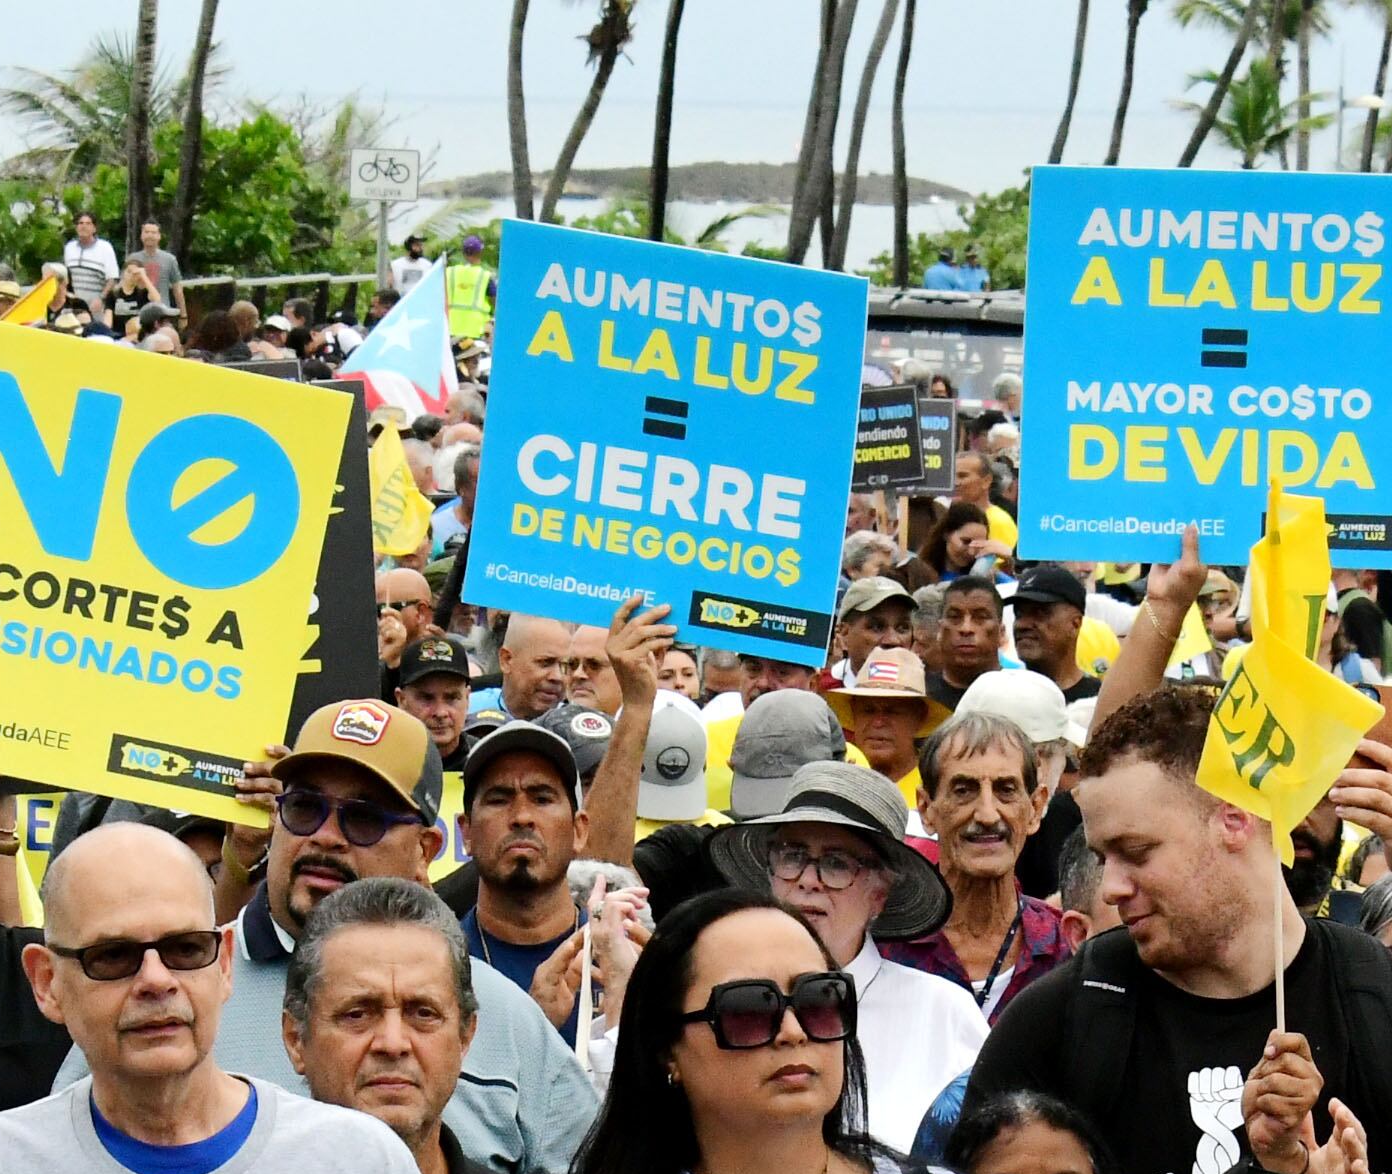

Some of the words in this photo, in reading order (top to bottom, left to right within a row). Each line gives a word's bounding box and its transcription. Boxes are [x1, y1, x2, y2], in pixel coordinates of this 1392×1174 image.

[1077, 208, 1385, 258] AUMENTO$
[536, 263, 823, 347] AUMENTO$
[1071, 256, 1122, 306] A
[1148, 257, 1236, 309] LA
[1251, 260, 1382, 315] LUZ
[527, 310, 574, 362] A
[598, 320, 680, 381] LA
[693, 341, 819, 405] LUZ
[1067, 381, 1214, 416] MAYOR
[1228, 383, 1372, 421] CO$TO
[855, 444, 911, 463] COMERCIO
[1068, 424, 1170, 484] DE
[1176, 427, 1376, 490] VIDA
[516, 434, 806, 540] CIERRE
[511, 503, 566, 542] DE
[573, 516, 801, 588] NEGOCIO$
[1338, 532, 1347, 540] A
[1349, 532, 1364, 540] LA
[1364, 532, 1386, 541] LUZ
[205, 609, 244, 650] A
[761, 621, 769, 629] A
[772, 622, 785, 632] LA
[786, 624, 807, 636] LUZ
[193, 769, 202, 780] A
[205, 772, 220, 783] LA
